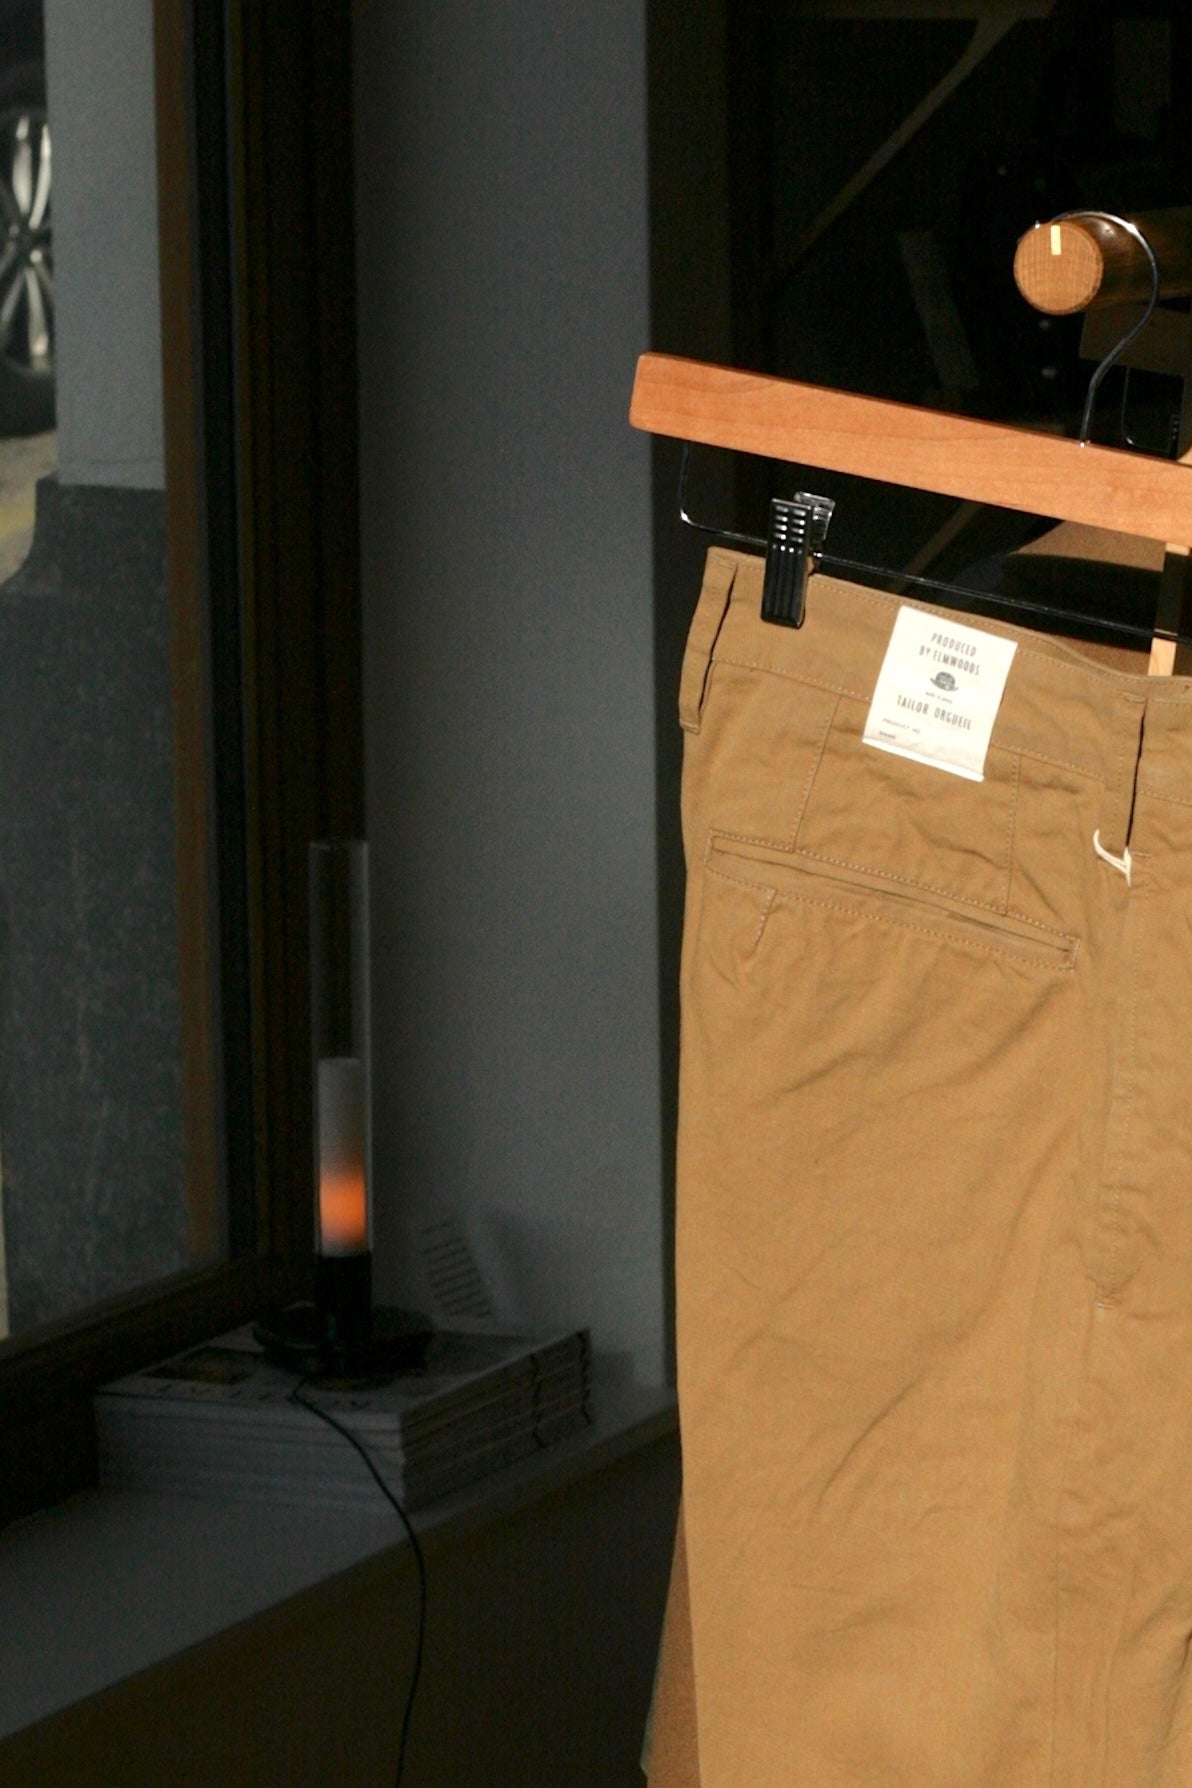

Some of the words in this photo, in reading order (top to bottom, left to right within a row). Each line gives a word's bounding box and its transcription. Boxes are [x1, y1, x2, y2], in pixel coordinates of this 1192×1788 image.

[919, 645, 931, 656] BY
[932, 650, 980, 676] ELMWOODS
[931, 633, 976, 657] PRODUCED
[897, 695, 929, 715] TAILOR
[934, 707, 972, 731] ORGUEIL
